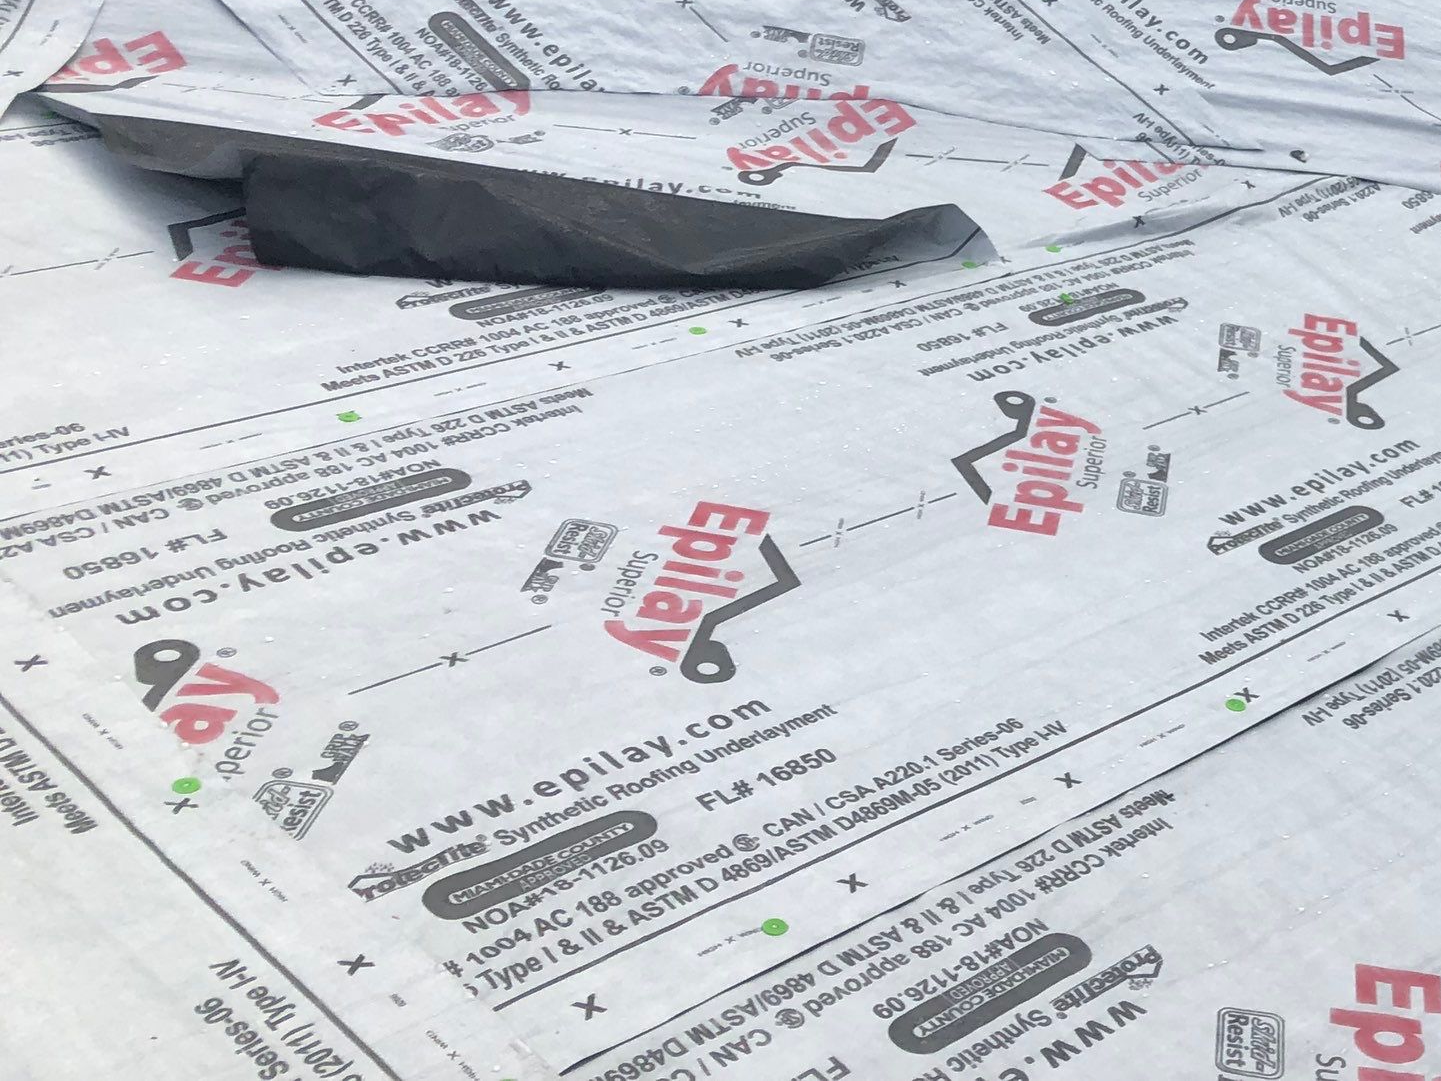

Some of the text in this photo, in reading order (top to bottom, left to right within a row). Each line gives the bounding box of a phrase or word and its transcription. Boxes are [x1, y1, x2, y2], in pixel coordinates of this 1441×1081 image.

[743, 61, 831, 86] Superior
[727, 99, 916, 172] Epilay
[737, 111, 817, 148] Superior
[1138, 169, 1203, 202] Superior
[967, 315, 1179, 383] www.epilay.com
[1274, 345, 1296, 388] Superior
[1283, 314, 1359, 415] Epilay
[987, 405, 1103, 536] Epilay
[1076, 434, 1108, 490] Superior
[1218, 439, 1421, 528] www.epilay.com
[1399, 488, 1432, 508] FL#
[63, 527, 228, 580] FL# 16850
[119, 508, 502, 625] www.epilay.com
[601, 549, 659, 620] Superior
[604, 500, 771, 663] Epilay
[215, 707, 279, 782] perior
[388, 697, 772, 854] www.epilay.com
[494, 703, 838, 848] Synthetic Roofing Underlayment
[696, 748, 837, 812] FL# 16850
[466, 927, 532, 965] 1004
[534, 909, 572, 937] AC
[576, 891, 622, 917] 188
[624, 844, 733, 899] approved
[763, 808, 816, 837] CAN
[825, 785, 876, 810] CSA
[873, 755, 939, 790] A220.1
[936, 718, 1024, 761] Series-06
[475, 955, 543, 991] Type
[558, 939, 584, 955] &
[580, 928, 603, 946] II
[602, 919, 628, 935] &
[628, 885, 698, 926] ASTM
[694, 877, 719, 893] D
[721, 825, 839, 885] 4869/ASTM
[833, 777, 942, 831] D4869M-05
[939, 754, 1000, 785] (2011)
[990, 736, 1039, 760] Type
[1015, 849, 1056, 873] 226
[1035, 817, 1173, 894] Intertek CCRR#
[1066, 814, 1123, 848] ASTM
[462, 839, 669, 933] NOA#18-1126.09
[1225, 1013, 1249, 1067] Resist
